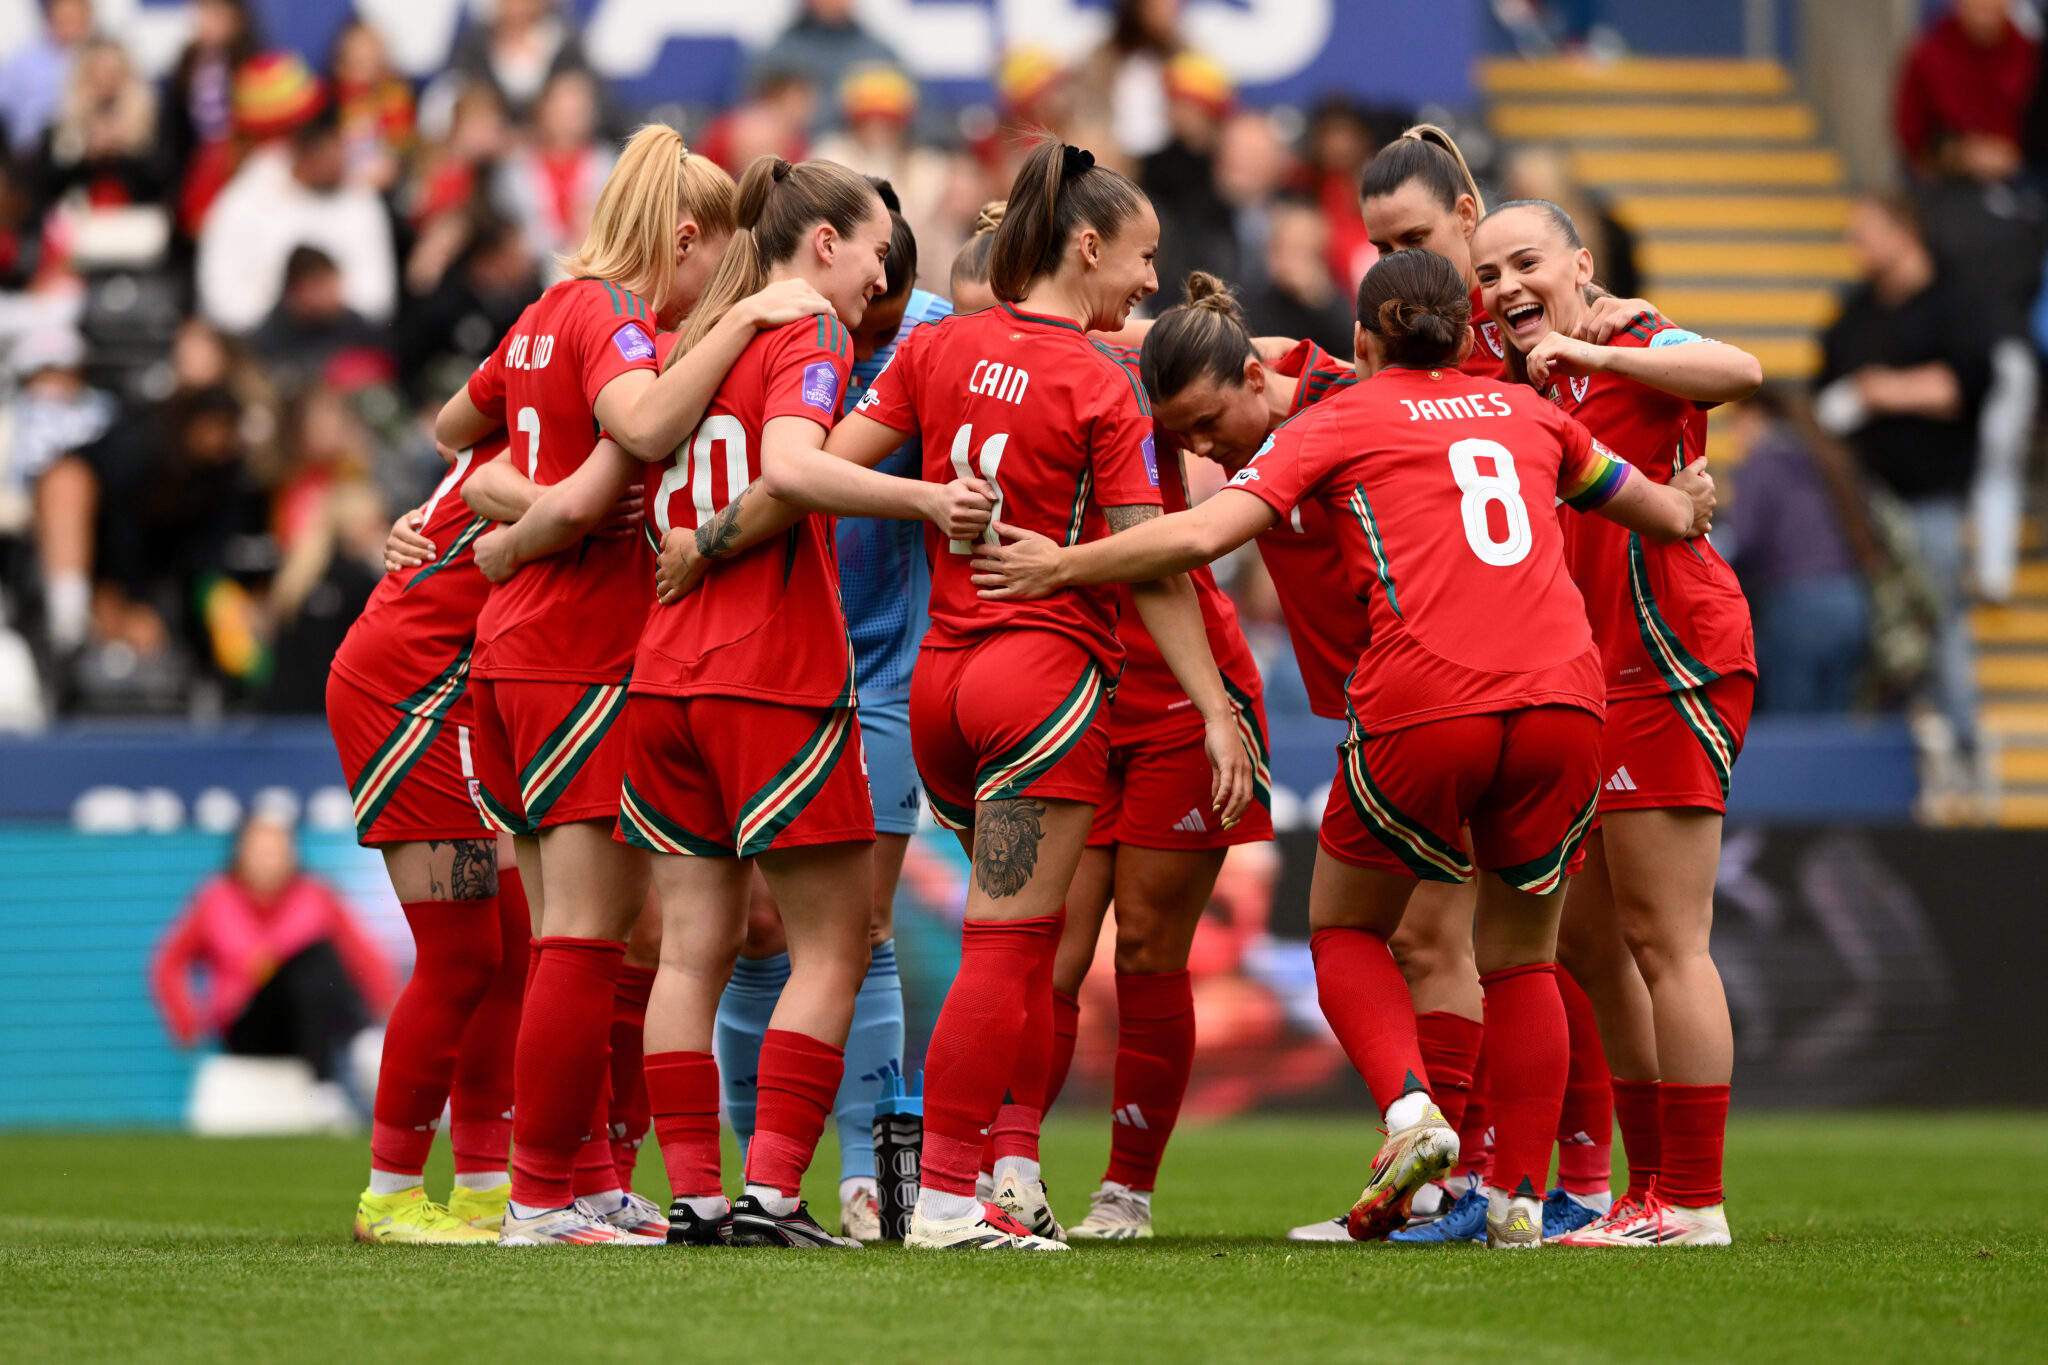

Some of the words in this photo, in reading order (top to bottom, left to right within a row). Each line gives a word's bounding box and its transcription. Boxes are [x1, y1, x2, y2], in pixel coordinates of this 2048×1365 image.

[505, 334, 554, 370] HOND
[969, 360, 1029, 405] CAIN
[1400, 393, 1512, 421] JAMES
[654, 414, 749, 534] 20
[1448, 438, 1532, 567] 8
[735, 1200, 749, 1208] KING
